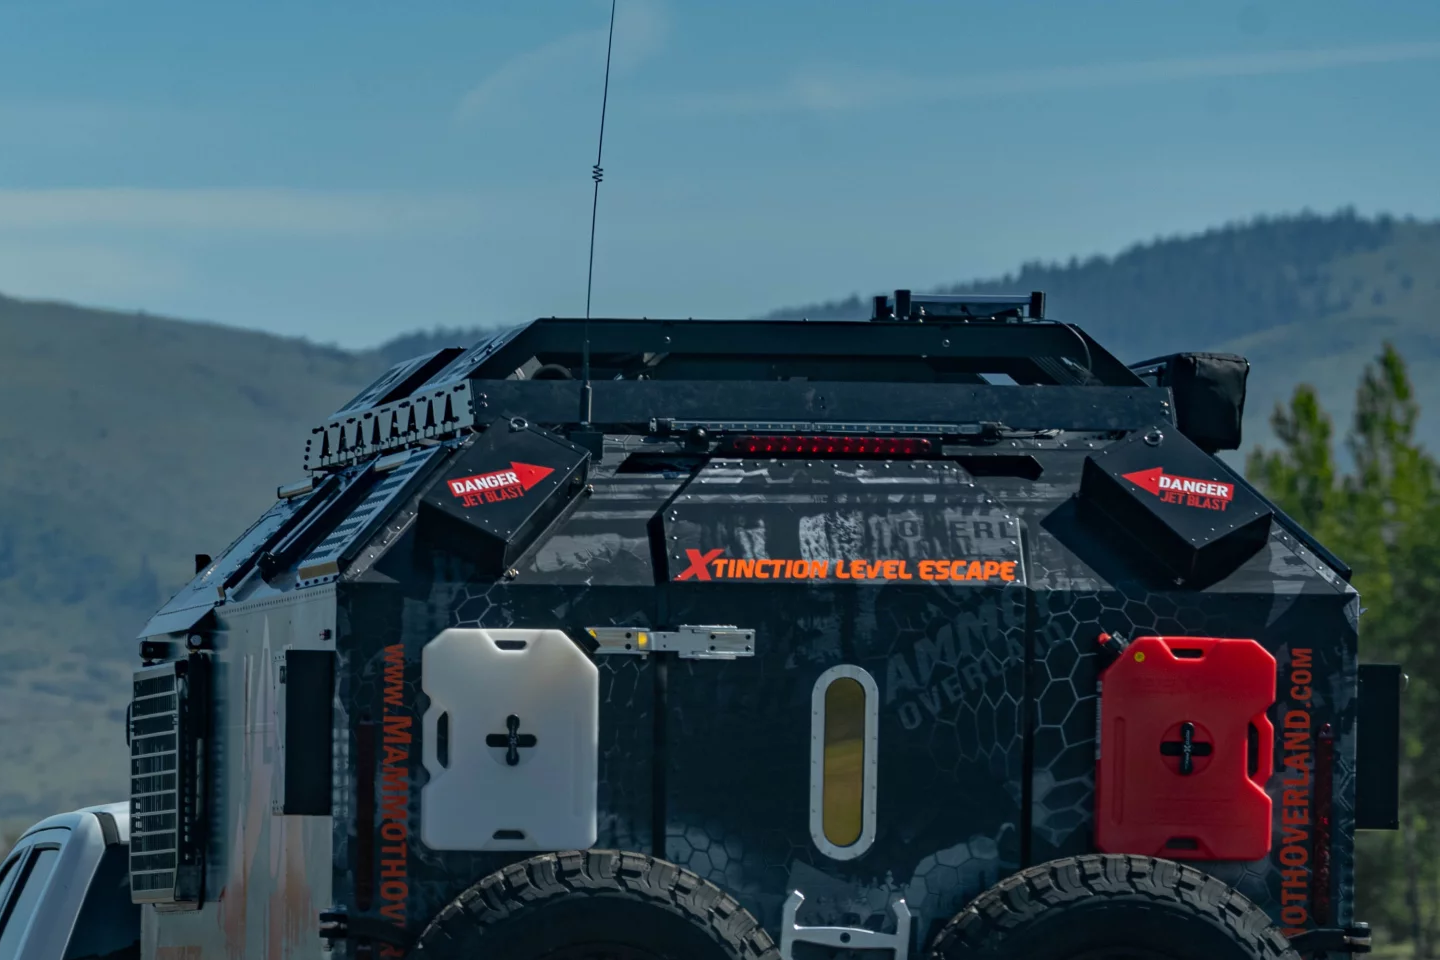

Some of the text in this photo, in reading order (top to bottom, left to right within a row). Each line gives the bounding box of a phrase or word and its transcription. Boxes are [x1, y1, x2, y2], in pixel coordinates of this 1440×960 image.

[451, 471, 520, 494] DANGER
[1158, 476, 1229, 498] DANGER
[462, 486, 525, 508] JET BLAST
[1160, 491, 1229, 512] JET BLAST
[673, 548, 1016, 582] XTINCTION LEVEL ESCAPE
